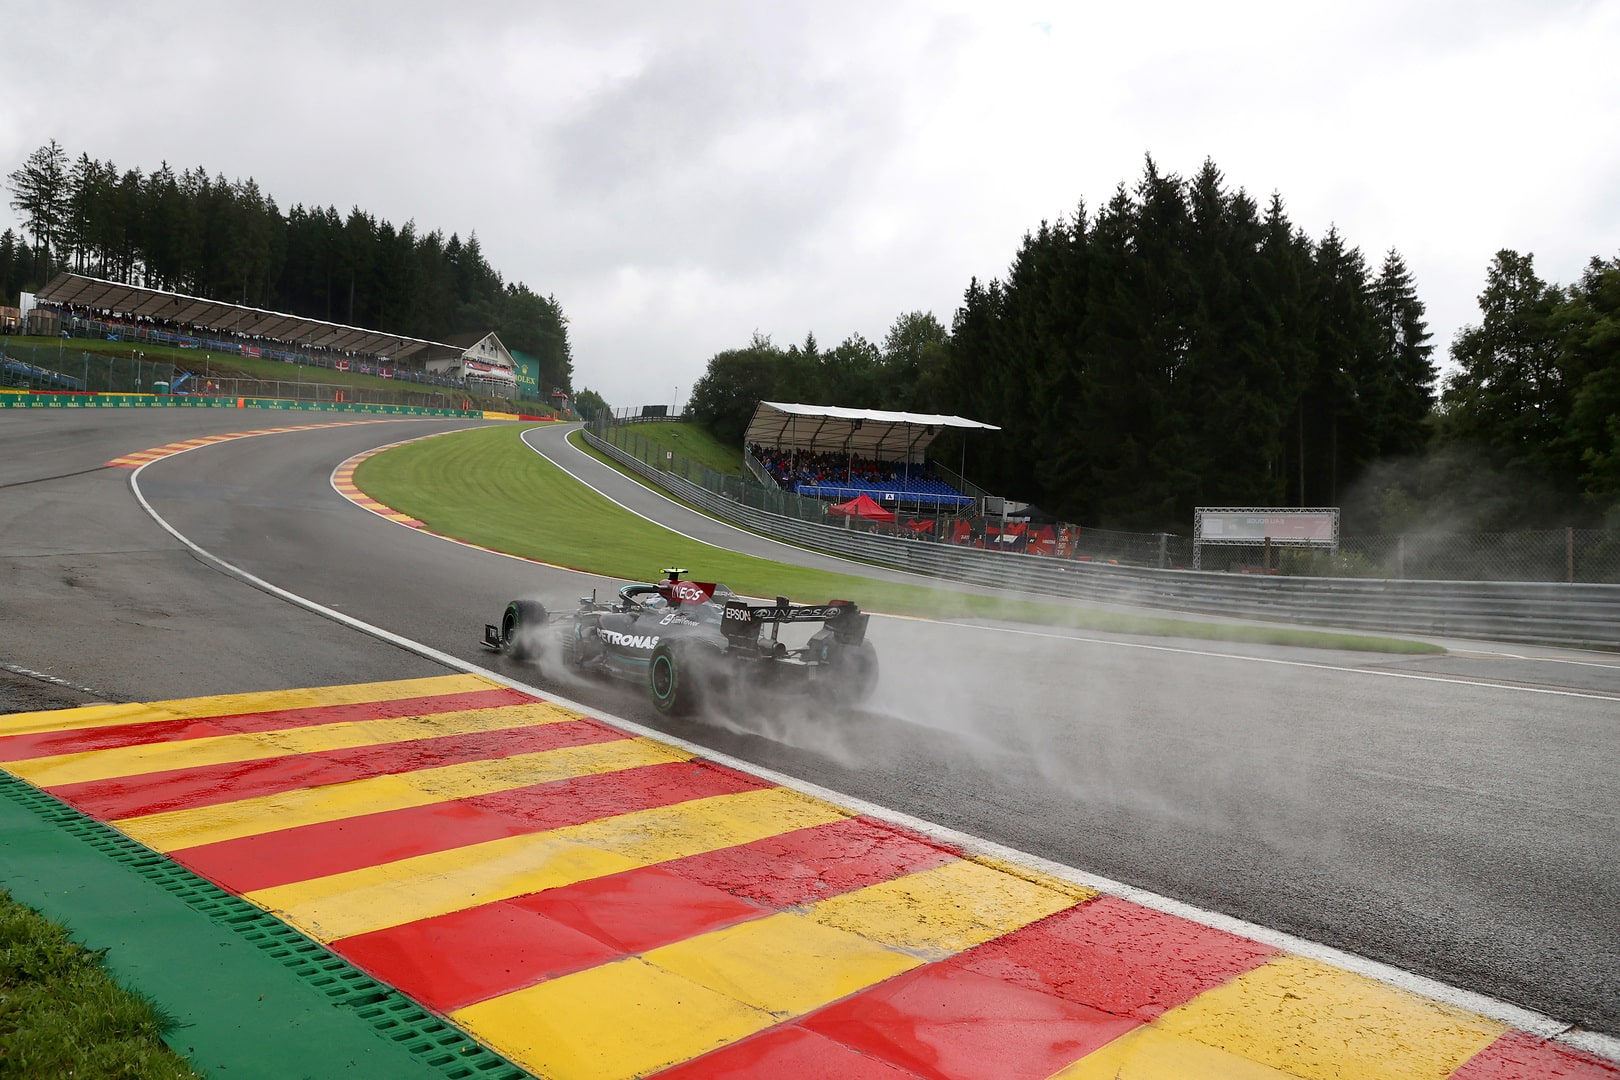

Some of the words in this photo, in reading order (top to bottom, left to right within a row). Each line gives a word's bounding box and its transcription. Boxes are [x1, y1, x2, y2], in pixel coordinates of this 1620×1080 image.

[672, 585, 704, 601] INEOS
[726, 608, 752, 622] EPSON
[773, 608, 822, 618] INEOS
[596, 628, 660, 650] PETRONAS
